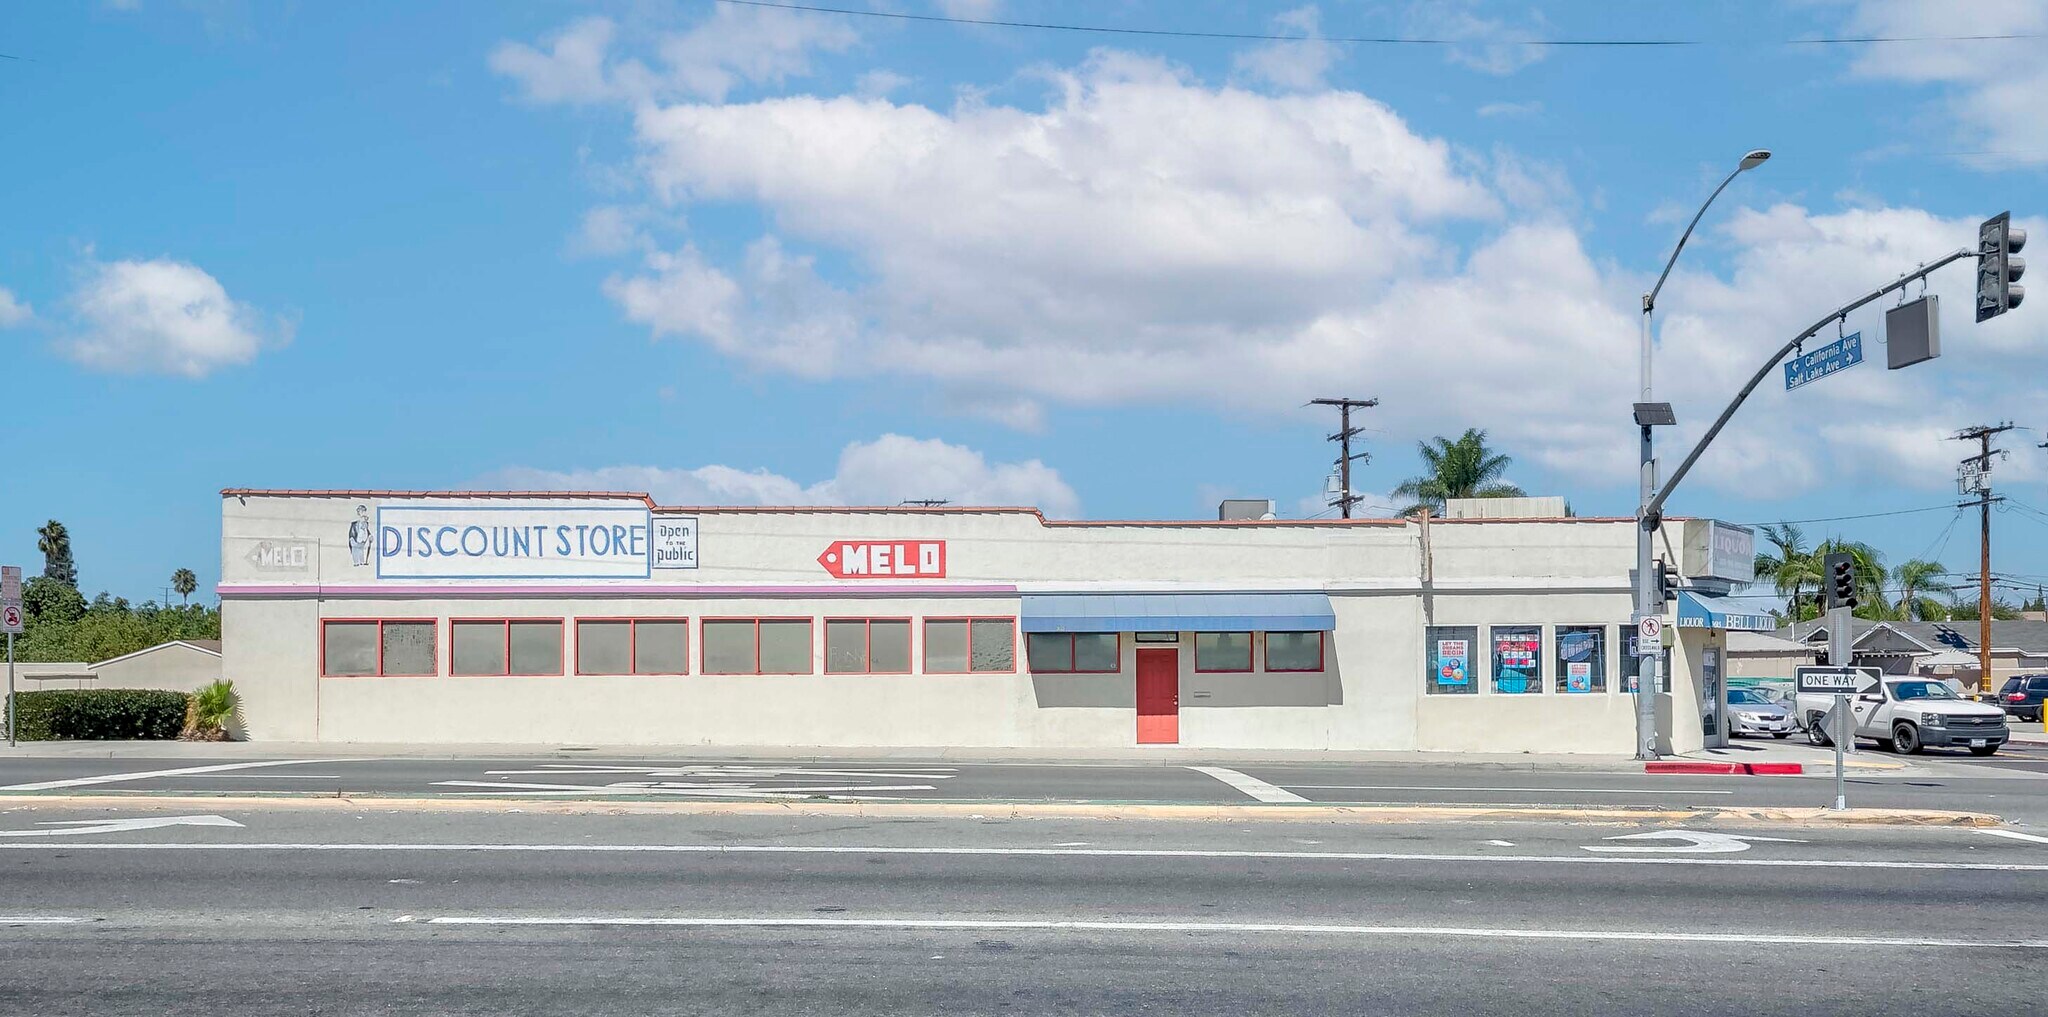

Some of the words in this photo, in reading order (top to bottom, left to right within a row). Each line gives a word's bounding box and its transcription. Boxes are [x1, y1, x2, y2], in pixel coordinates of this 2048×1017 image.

[1805, 345, 1840, 368] California
[1842, 337, 1857, 352] Ave
[1789, 372, 1804, 388] Salt
[1805, 366, 1824, 381] Lake
[1825, 359, 1840, 374] Ave
[382, 525, 548, 557] DISCOUNT
[556, 525, 647, 556] STORE
[660, 525, 690, 542] Open
[656, 546, 694, 564] public
[1680, 617, 1704, 628] LIQUOR
[1725, 614, 1752, 630] BELL
[1806, 675, 1829, 686] ONE
[1833, 675, 1857, 686] WAY
